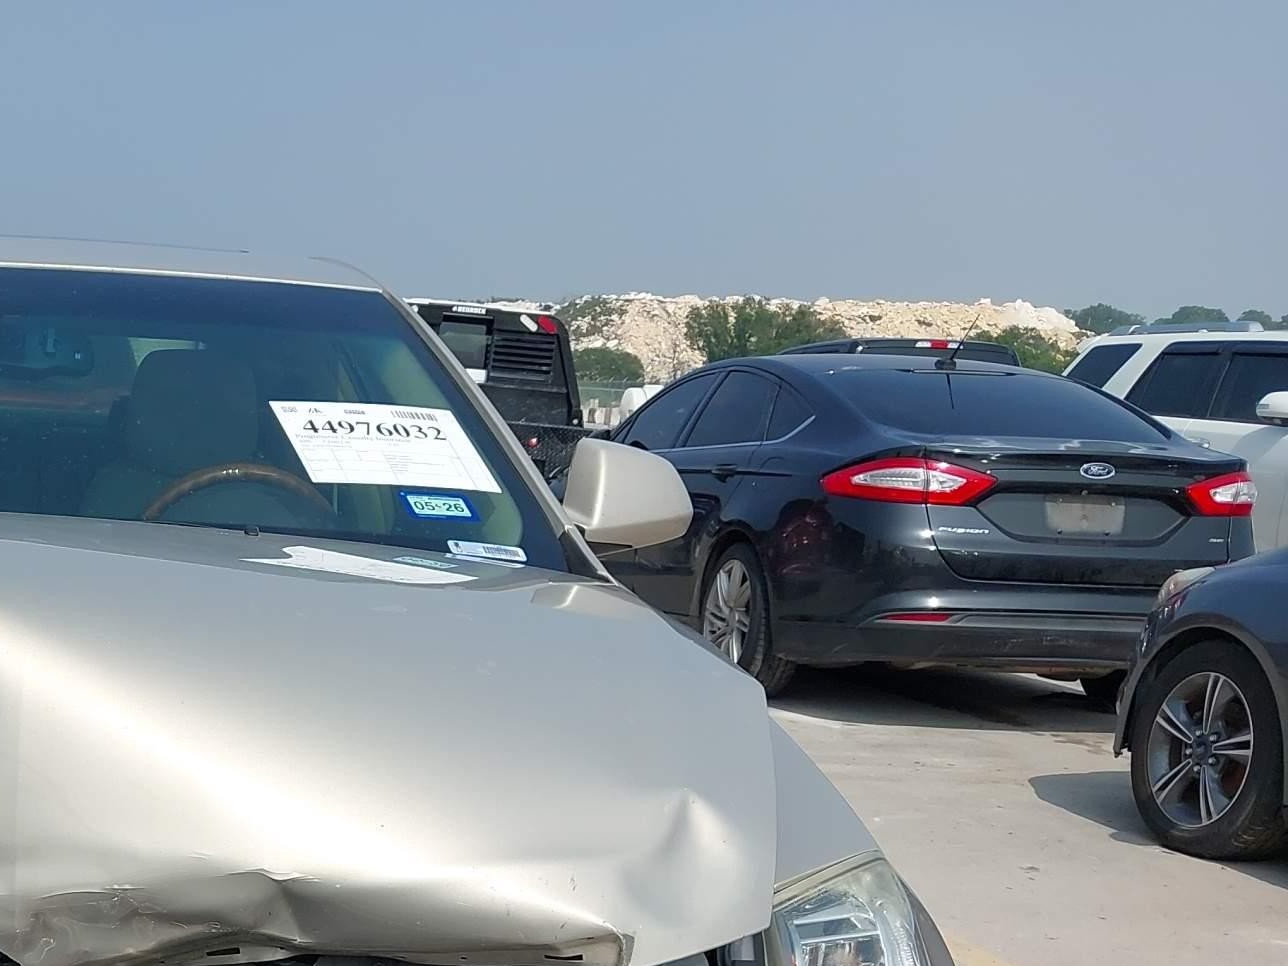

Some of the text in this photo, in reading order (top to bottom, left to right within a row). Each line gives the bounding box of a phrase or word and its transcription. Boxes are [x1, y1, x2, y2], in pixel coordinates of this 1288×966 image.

[303, 419, 447, 441] 44976032
[413, 500, 465, 513] 05 26
